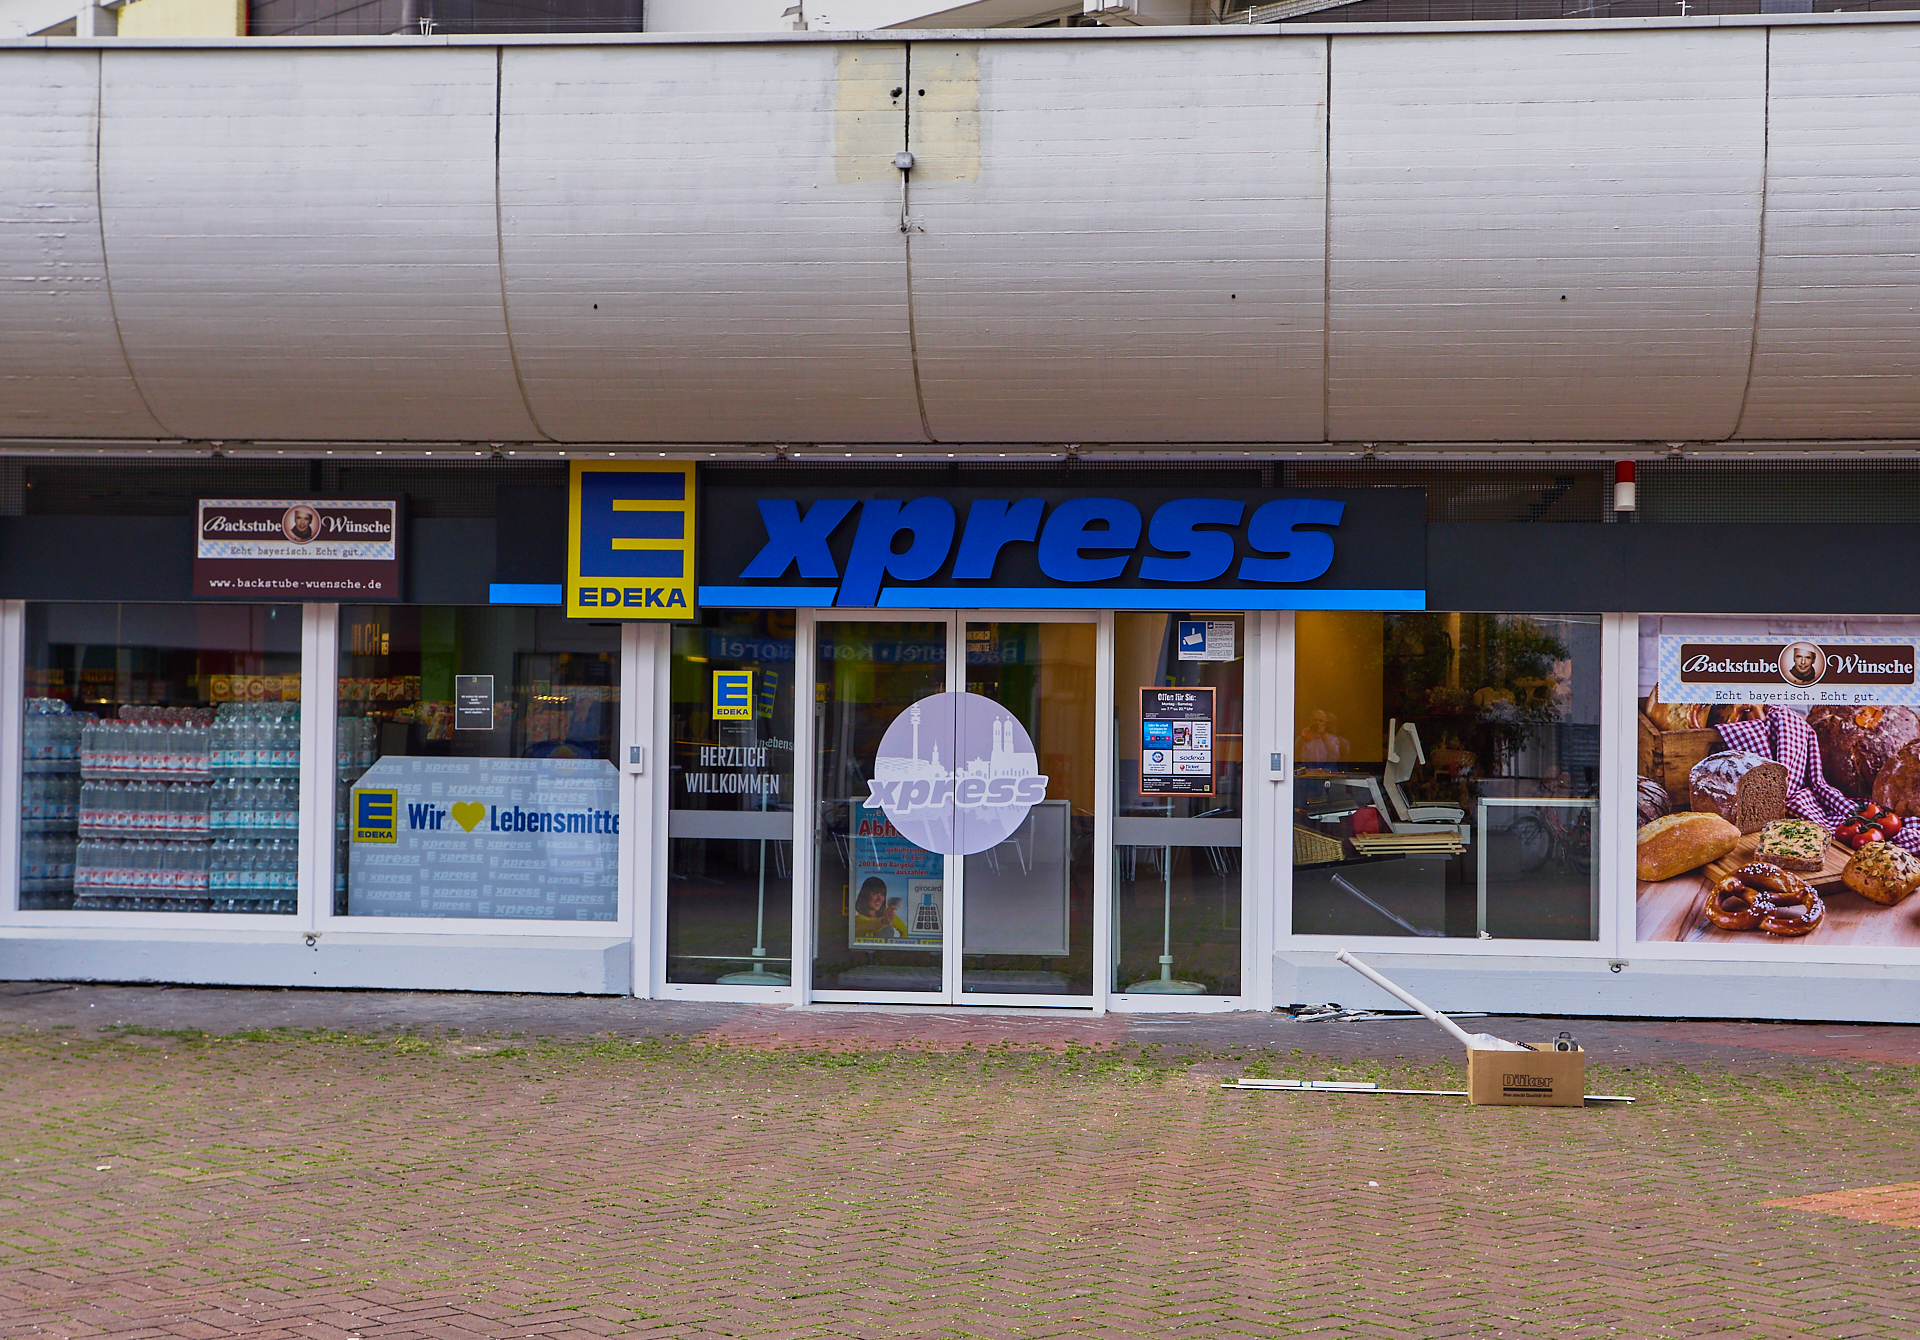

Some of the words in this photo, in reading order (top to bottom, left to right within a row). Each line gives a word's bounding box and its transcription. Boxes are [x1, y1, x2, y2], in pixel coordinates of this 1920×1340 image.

[204, 516, 281, 532] Backstube
[322, 516, 390, 533] Wünsche
[231, 547, 252, 555] Echt
[258, 547, 312, 556] bayerisch.
[343, 549, 363, 557] gut.
[739, 496, 1346, 607] xpress
[210, 578, 381, 589] www.backstube-wuensche.de
[579, 587, 687, 607] EDEKA
[1682, 655, 1777, 673] Backstube
[1827, 654, 1912, 674] Wünsche
[1157, 693, 1174, 701] Offen
[1715, 691, 1742, 699] Echt
[1749, 691, 1815, 702] bayerisch.
[1821, 692, 1847, 701] Echt
[1854, 693, 1879, 703] gut.
[700, 746, 766, 767] HERZLICH
[685, 772, 780, 794] WILLKOMMEN
[864, 776, 1048, 813] xpress
[408, 804, 445, 830] Wir
[858, 819, 904, 837] Abh
[1503, 1074, 1553, 1087] Düker
